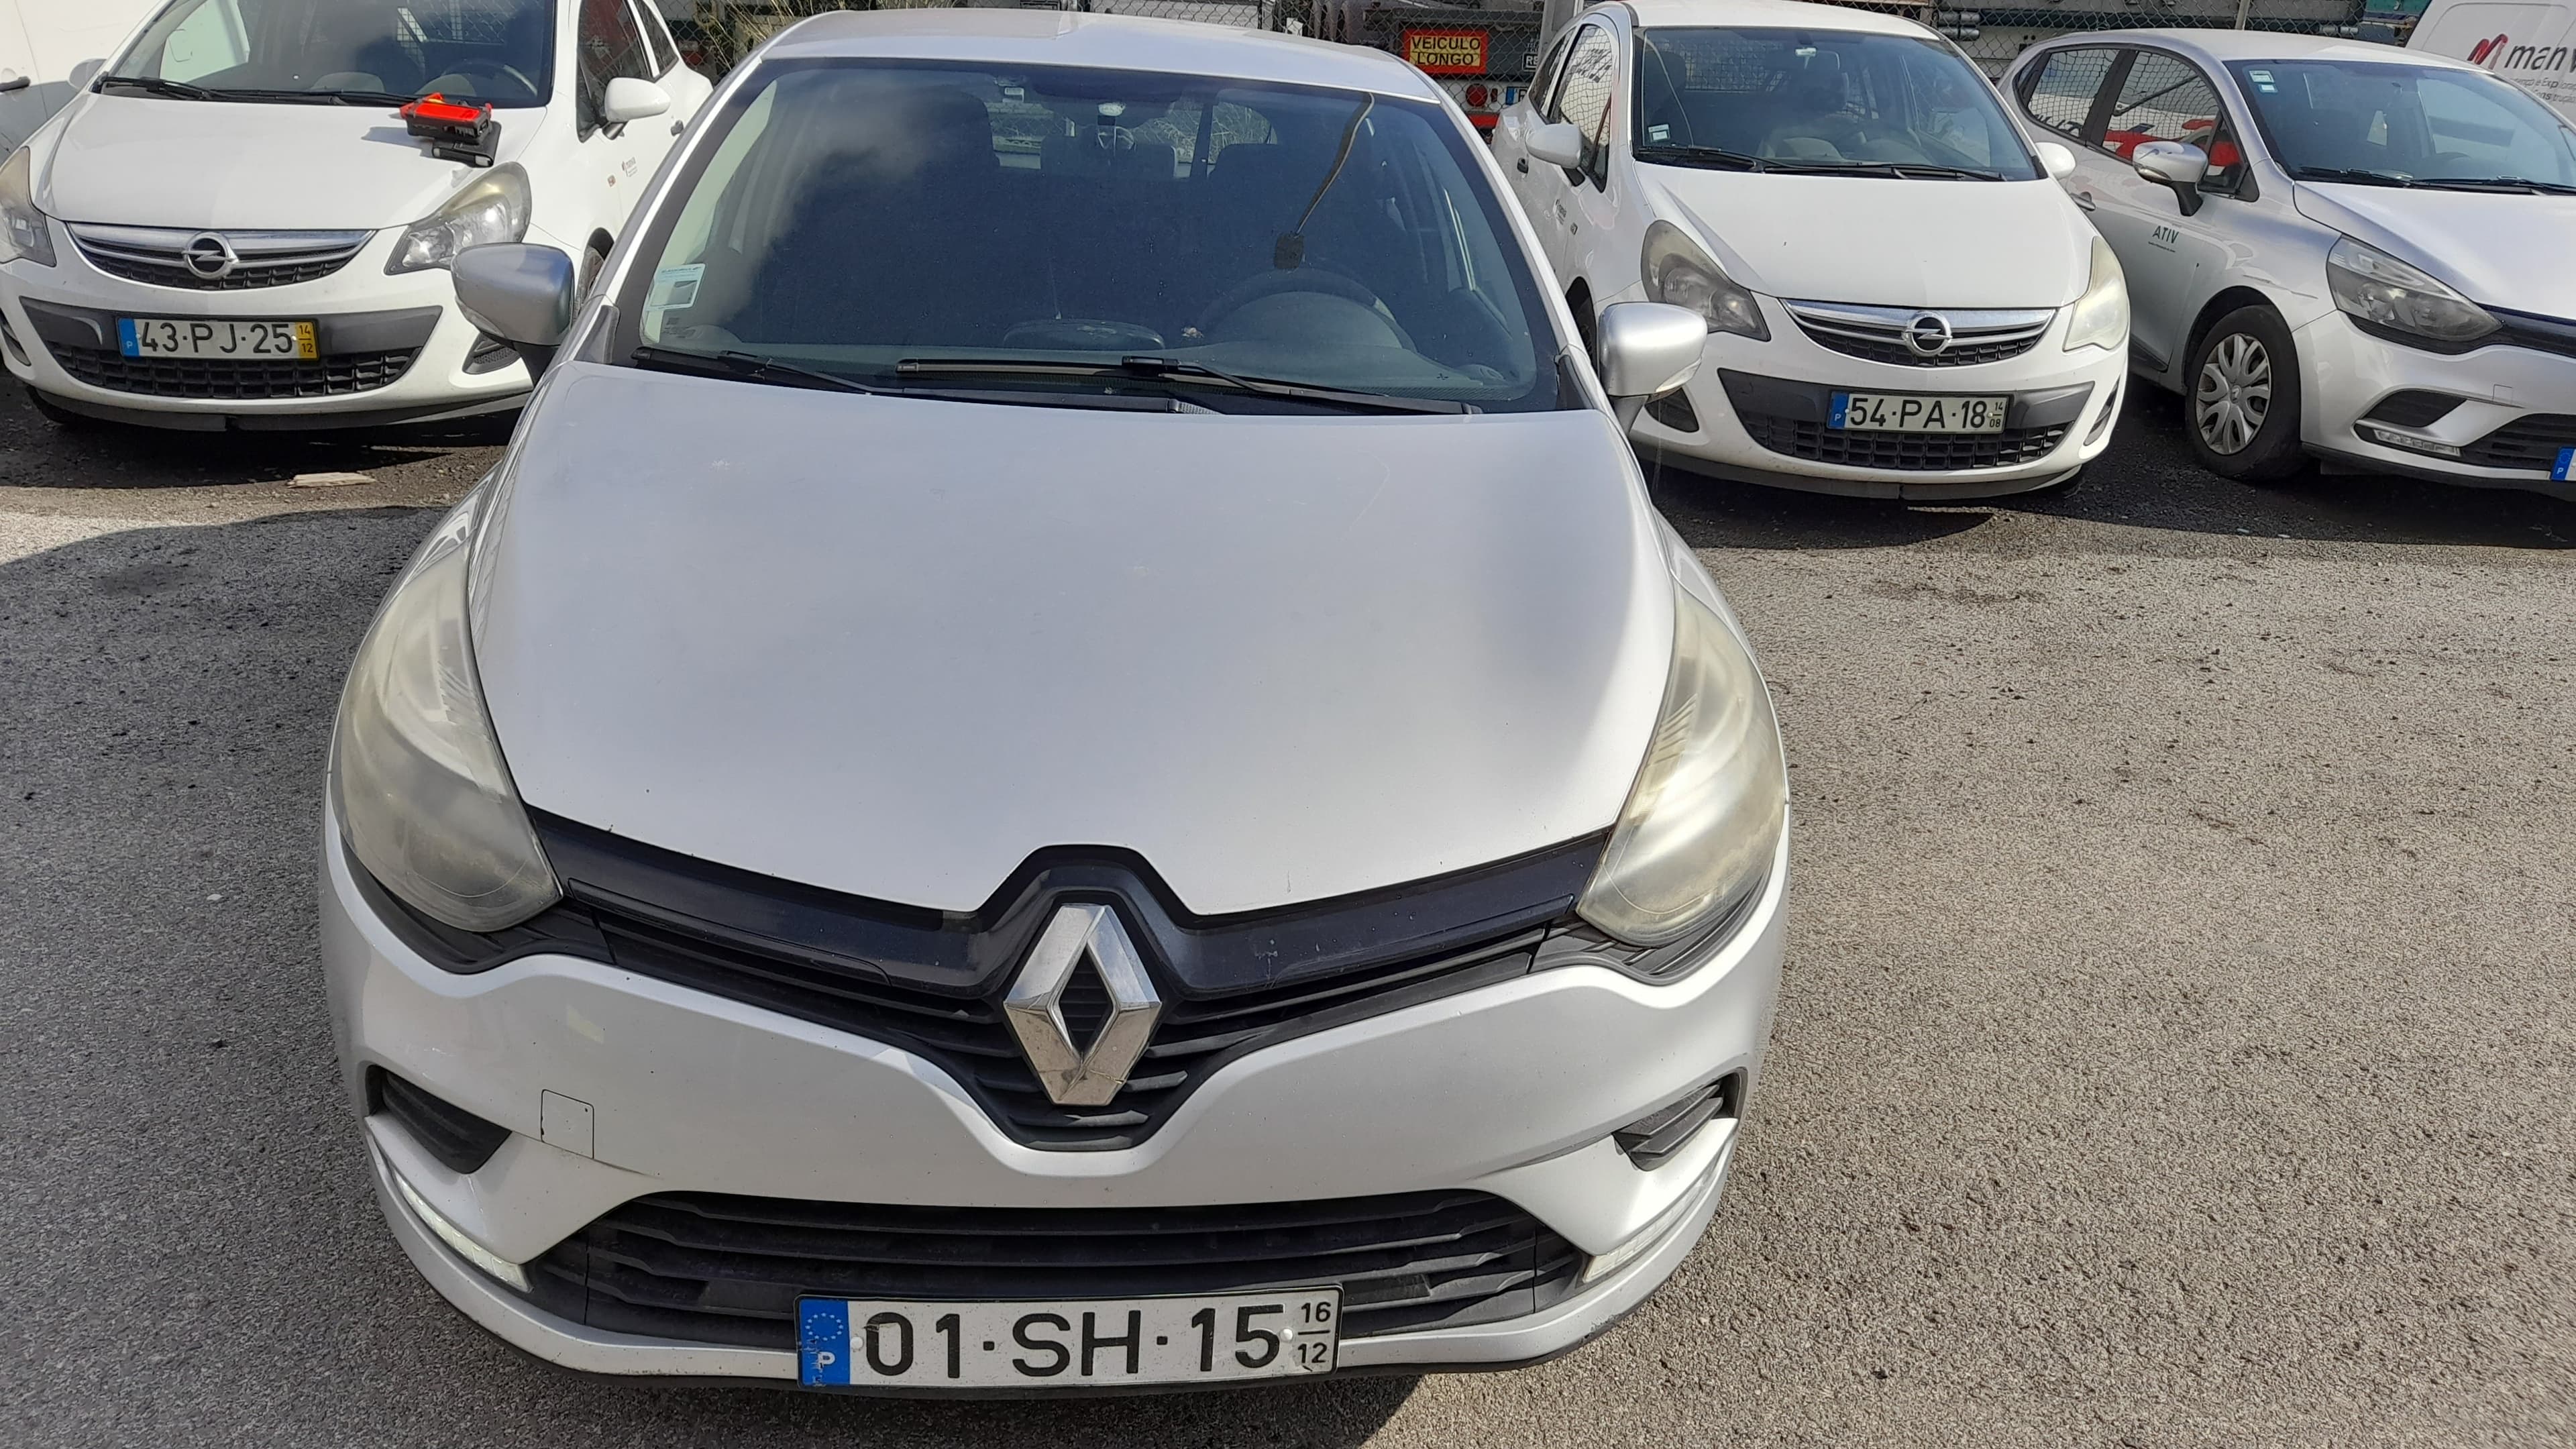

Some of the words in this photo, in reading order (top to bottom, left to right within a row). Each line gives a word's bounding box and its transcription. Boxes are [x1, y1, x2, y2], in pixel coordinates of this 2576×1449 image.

[1411, 36, 1481, 50] VEICULO
[1417, 53, 1474, 66] LONGO
[2151, 225, 2180, 244] ATIV
[298, 324, 311, 335] 14
[125, 341, 133, 350] P
[301, 343, 314, 354] 12
[1994, 401, 2004, 411] 14
[1834, 413, 1842, 422] P
[1989, 418, 2002, 428] 08
[2557, 467, 2565, 475] P
[1301, 1301, 1332, 1324] 16
[1297, 1342, 1328, 1364] 12
[816, 1351, 836, 1373] P
